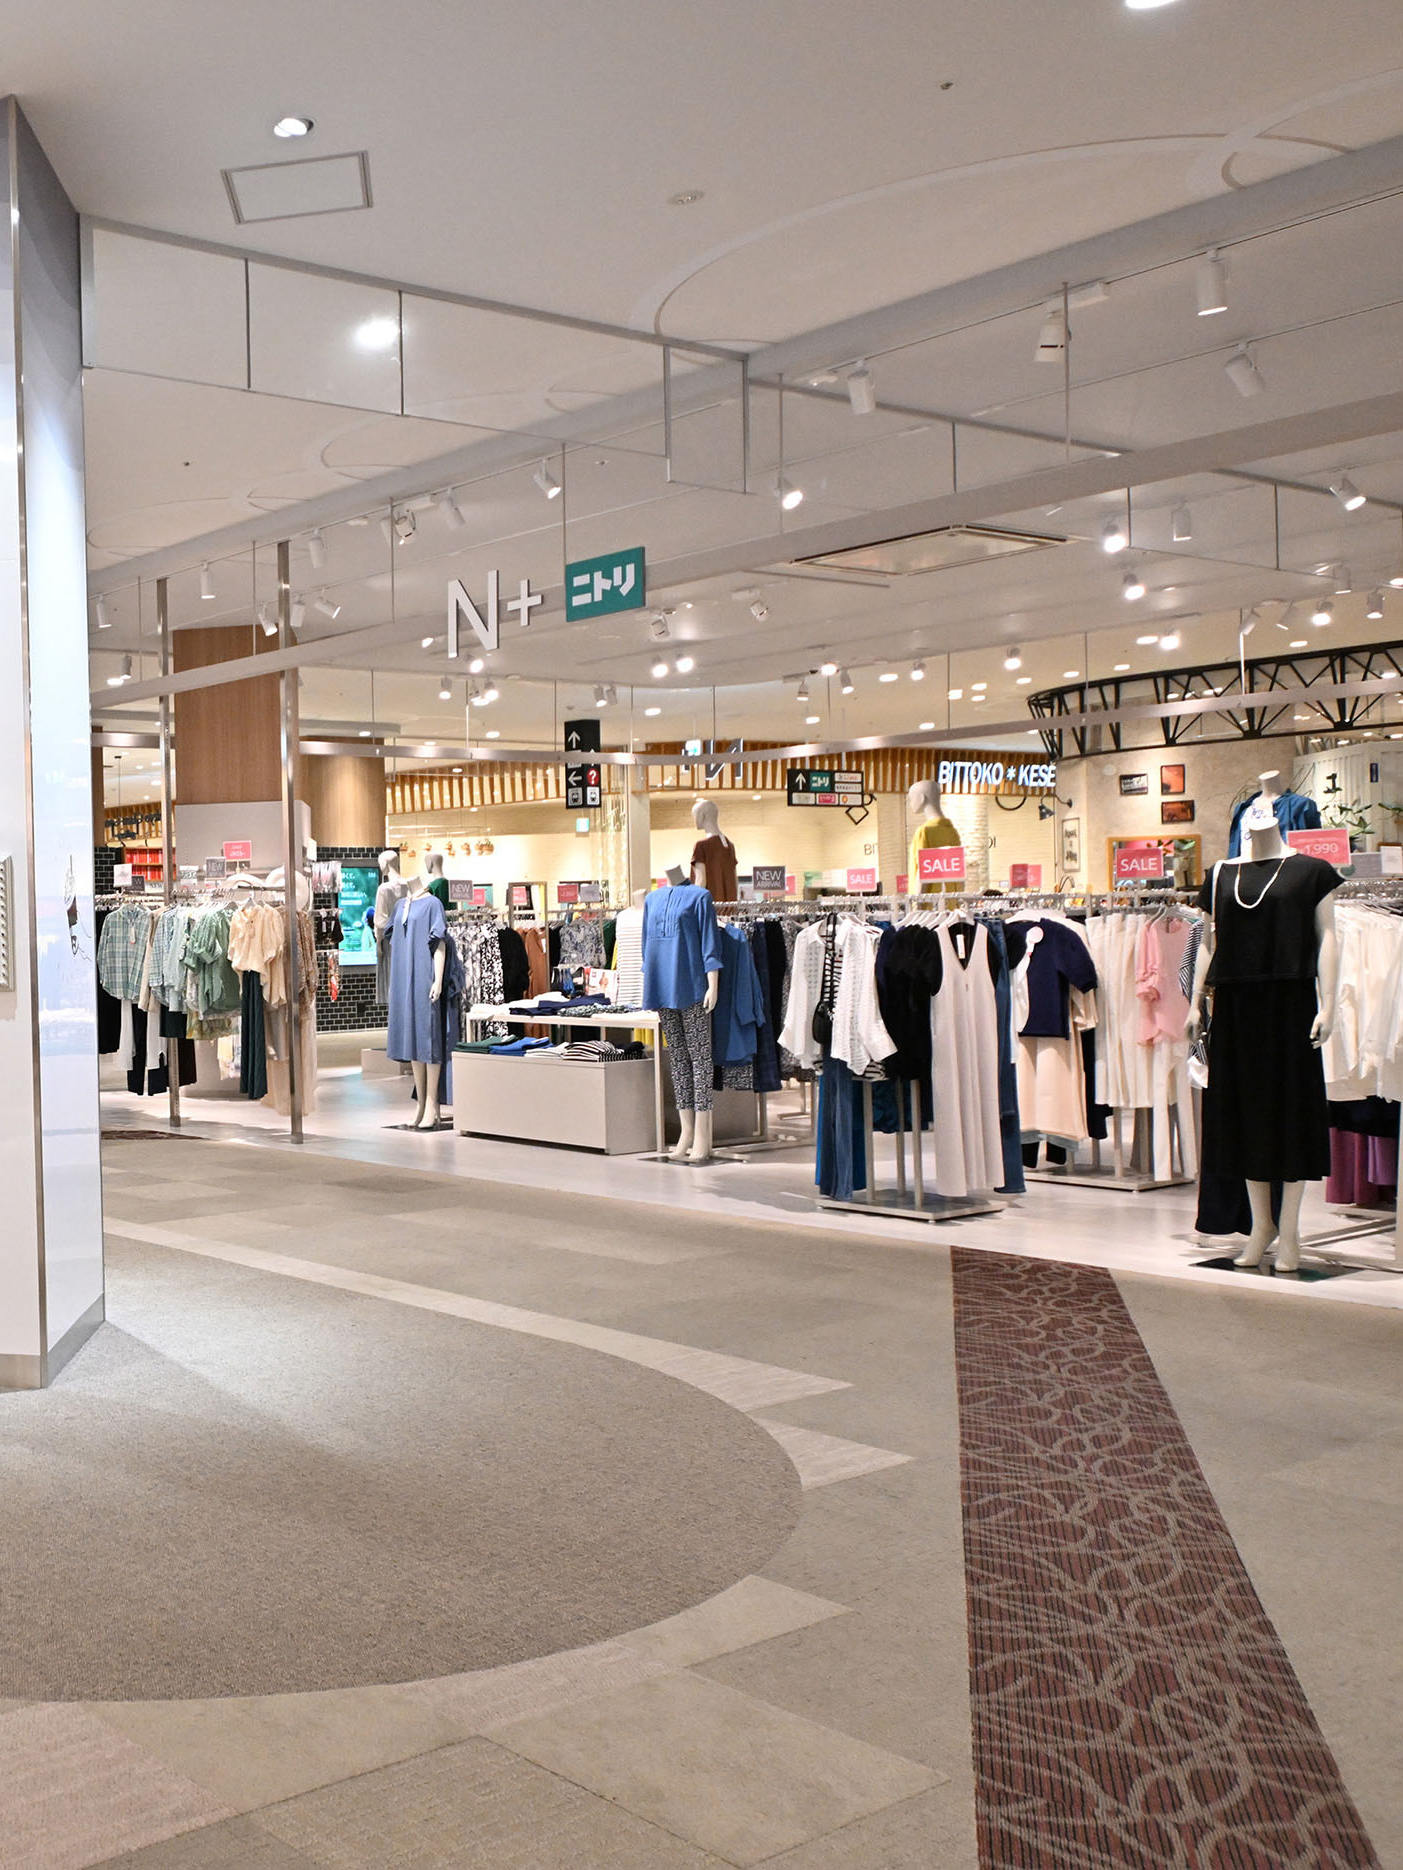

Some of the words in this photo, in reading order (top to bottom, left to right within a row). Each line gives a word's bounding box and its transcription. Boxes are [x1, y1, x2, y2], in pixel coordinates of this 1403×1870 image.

[571, 562, 636, 607] ニトリ
[937, 760, 1004, 786] BITTOKO
[811, 775, 830, 788] ニトリ
[922, 857, 961, 873] SALE
[1119, 857, 1159, 872] SALE
[756, 870, 782, 881] NEW
[849, 874, 873, 885] SALE
[451, 884, 470, 893] NEW
